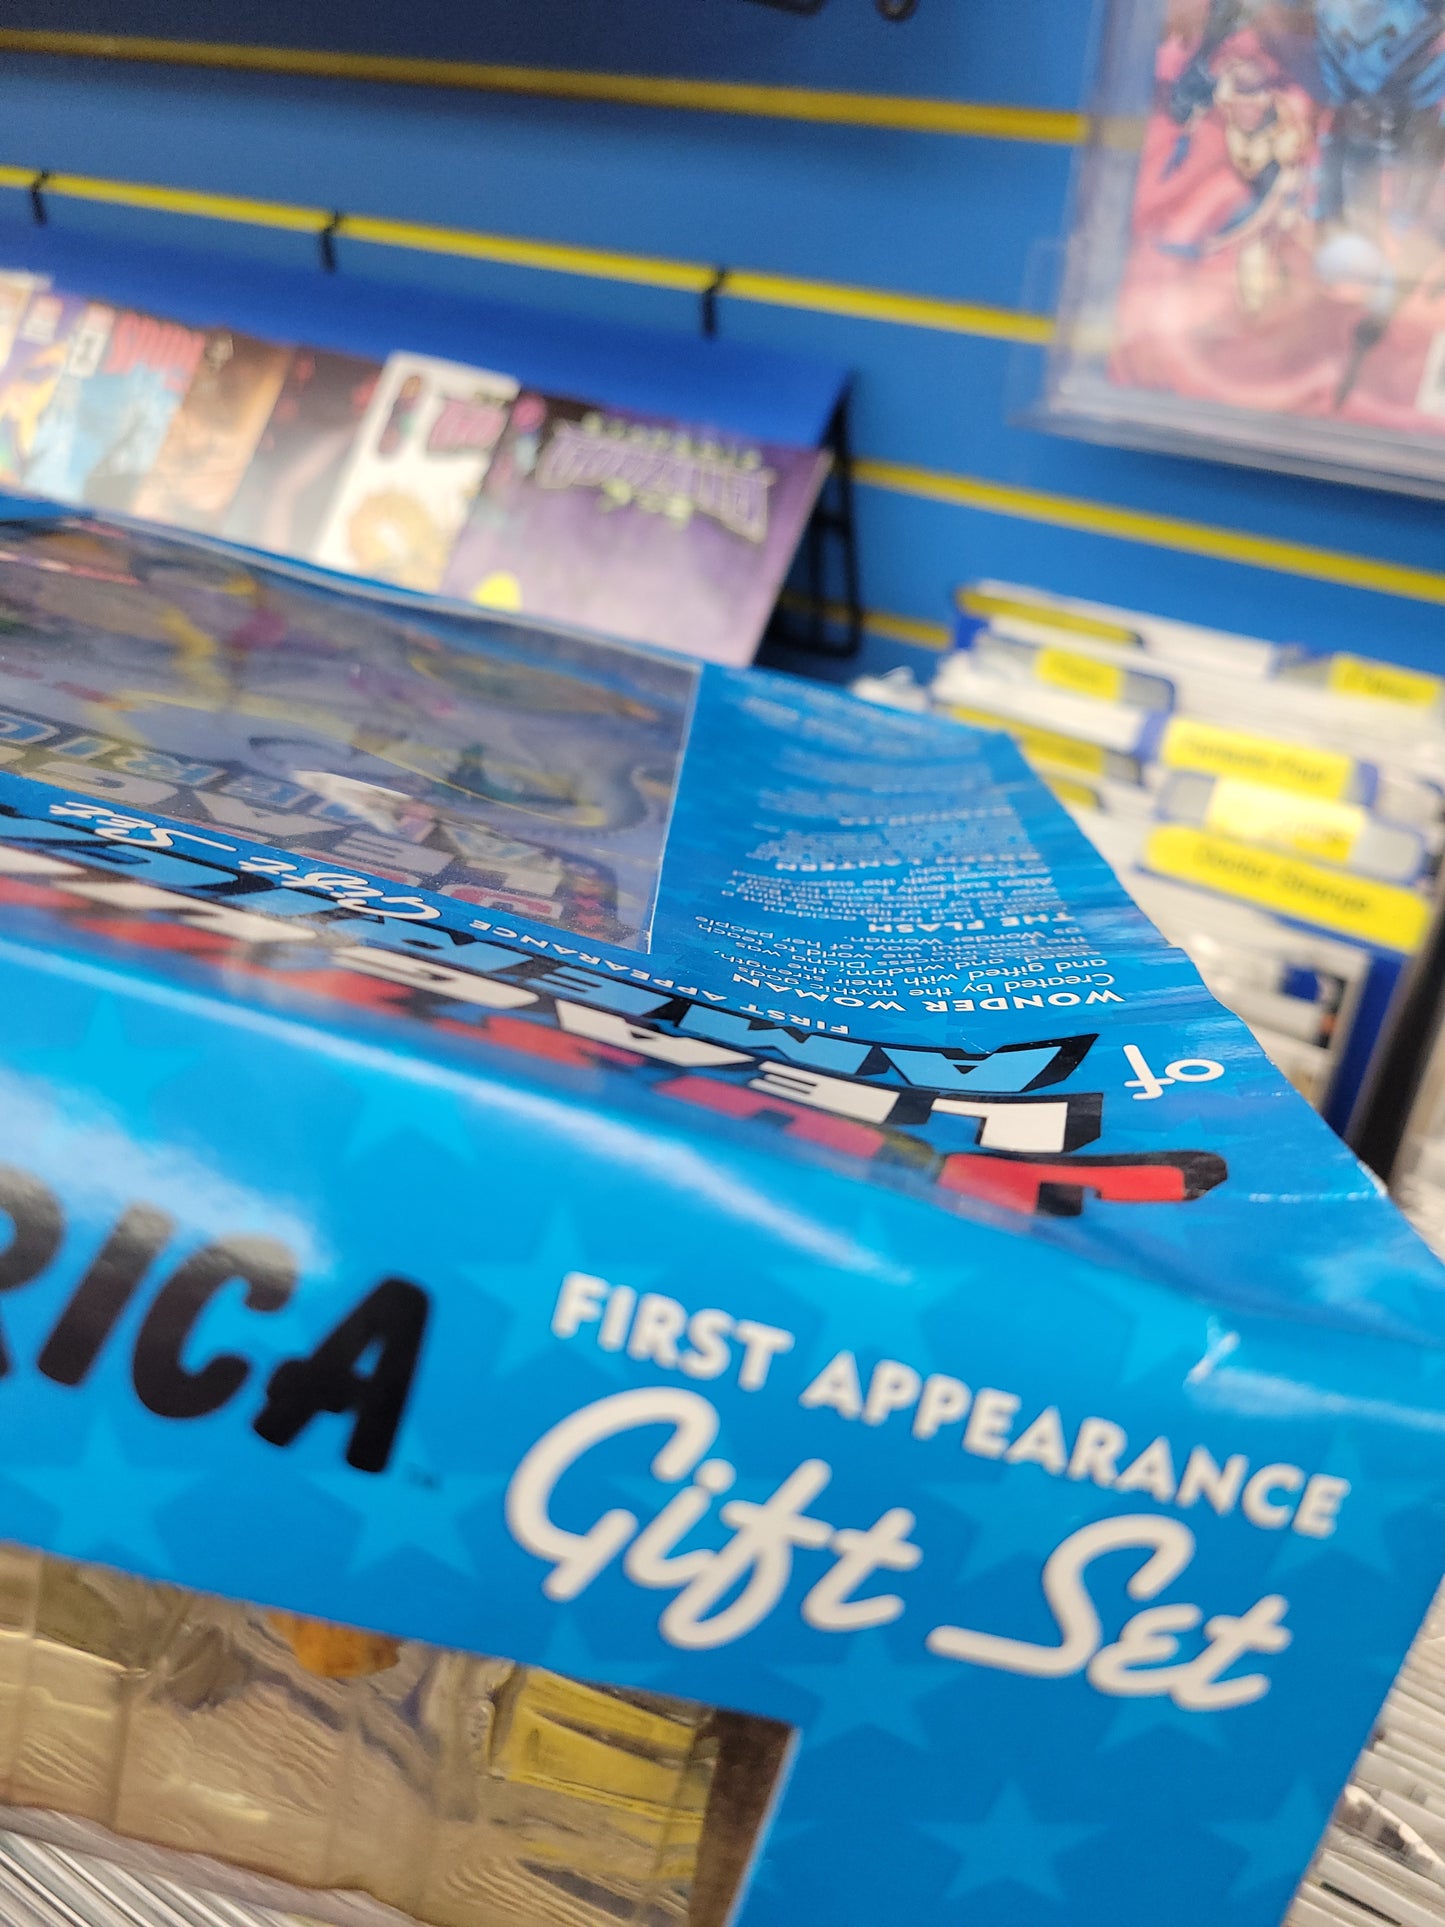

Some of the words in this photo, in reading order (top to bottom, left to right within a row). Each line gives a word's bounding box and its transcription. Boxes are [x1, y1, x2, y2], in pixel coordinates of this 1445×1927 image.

[48, 801, 238, 853] Set
[238, 855, 442, 921] Gift
[868, 919, 985, 933] FLASH
[1000, 911, 1077, 927] THE
[695, 915, 774, 939] people
[698, 923, 765, 946] teach
[1053, 926, 1081, 935] as
[781, 937, 821, 949] her
[843, 936, 944, 946] Woman.
[950, 931, 1047, 943] Wonder
[1046, 935, 1087, 945] the
[735, 941, 782, 958] was
[773, 942, 798, 953] to
[830, 943, 854, 951] of
[863, 944, 922, 952] ways
[931, 939, 1039, 951] peaceful
[468, 917, 729, 1003] APPEARANCE
[807, 948, 873, 959] world
[713, 950, 824, 982] strength,
[787, 962, 829, 975] the
[791, 954, 866, 969] Diana
[954, 958, 1005, 971] and
[1054, 958, 1109, 973] and
[737, 966, 801, 985] gods
[849, 964, 945, 977] wisdom,
[968, 962, 1046, 982] gifted
[833, 978, 895, 988] their
[903, 972, 959, 986] with
[1003, 973, 1116, 993] Created
[732, 973, 907, 1013] WOMAN
[809, 983, 899, 997] mythic
[908, 986, 954, 997] the
[961, 982, 995, 995] by
[922, 990, 1126, 1013] WONDER
[739, 1003, 851, 1035] FIRST
[0, 874, 1228, 1216] JUSTI
[1123, 1044, 1226, 1102] of
[552, 1270, 794, 1392] FIRST
[799, 1349, 1352, 1539] APPEARANCE
[505, 1385, 923, 1651] Gift
[926, 1512, 1293, 1712] Set
